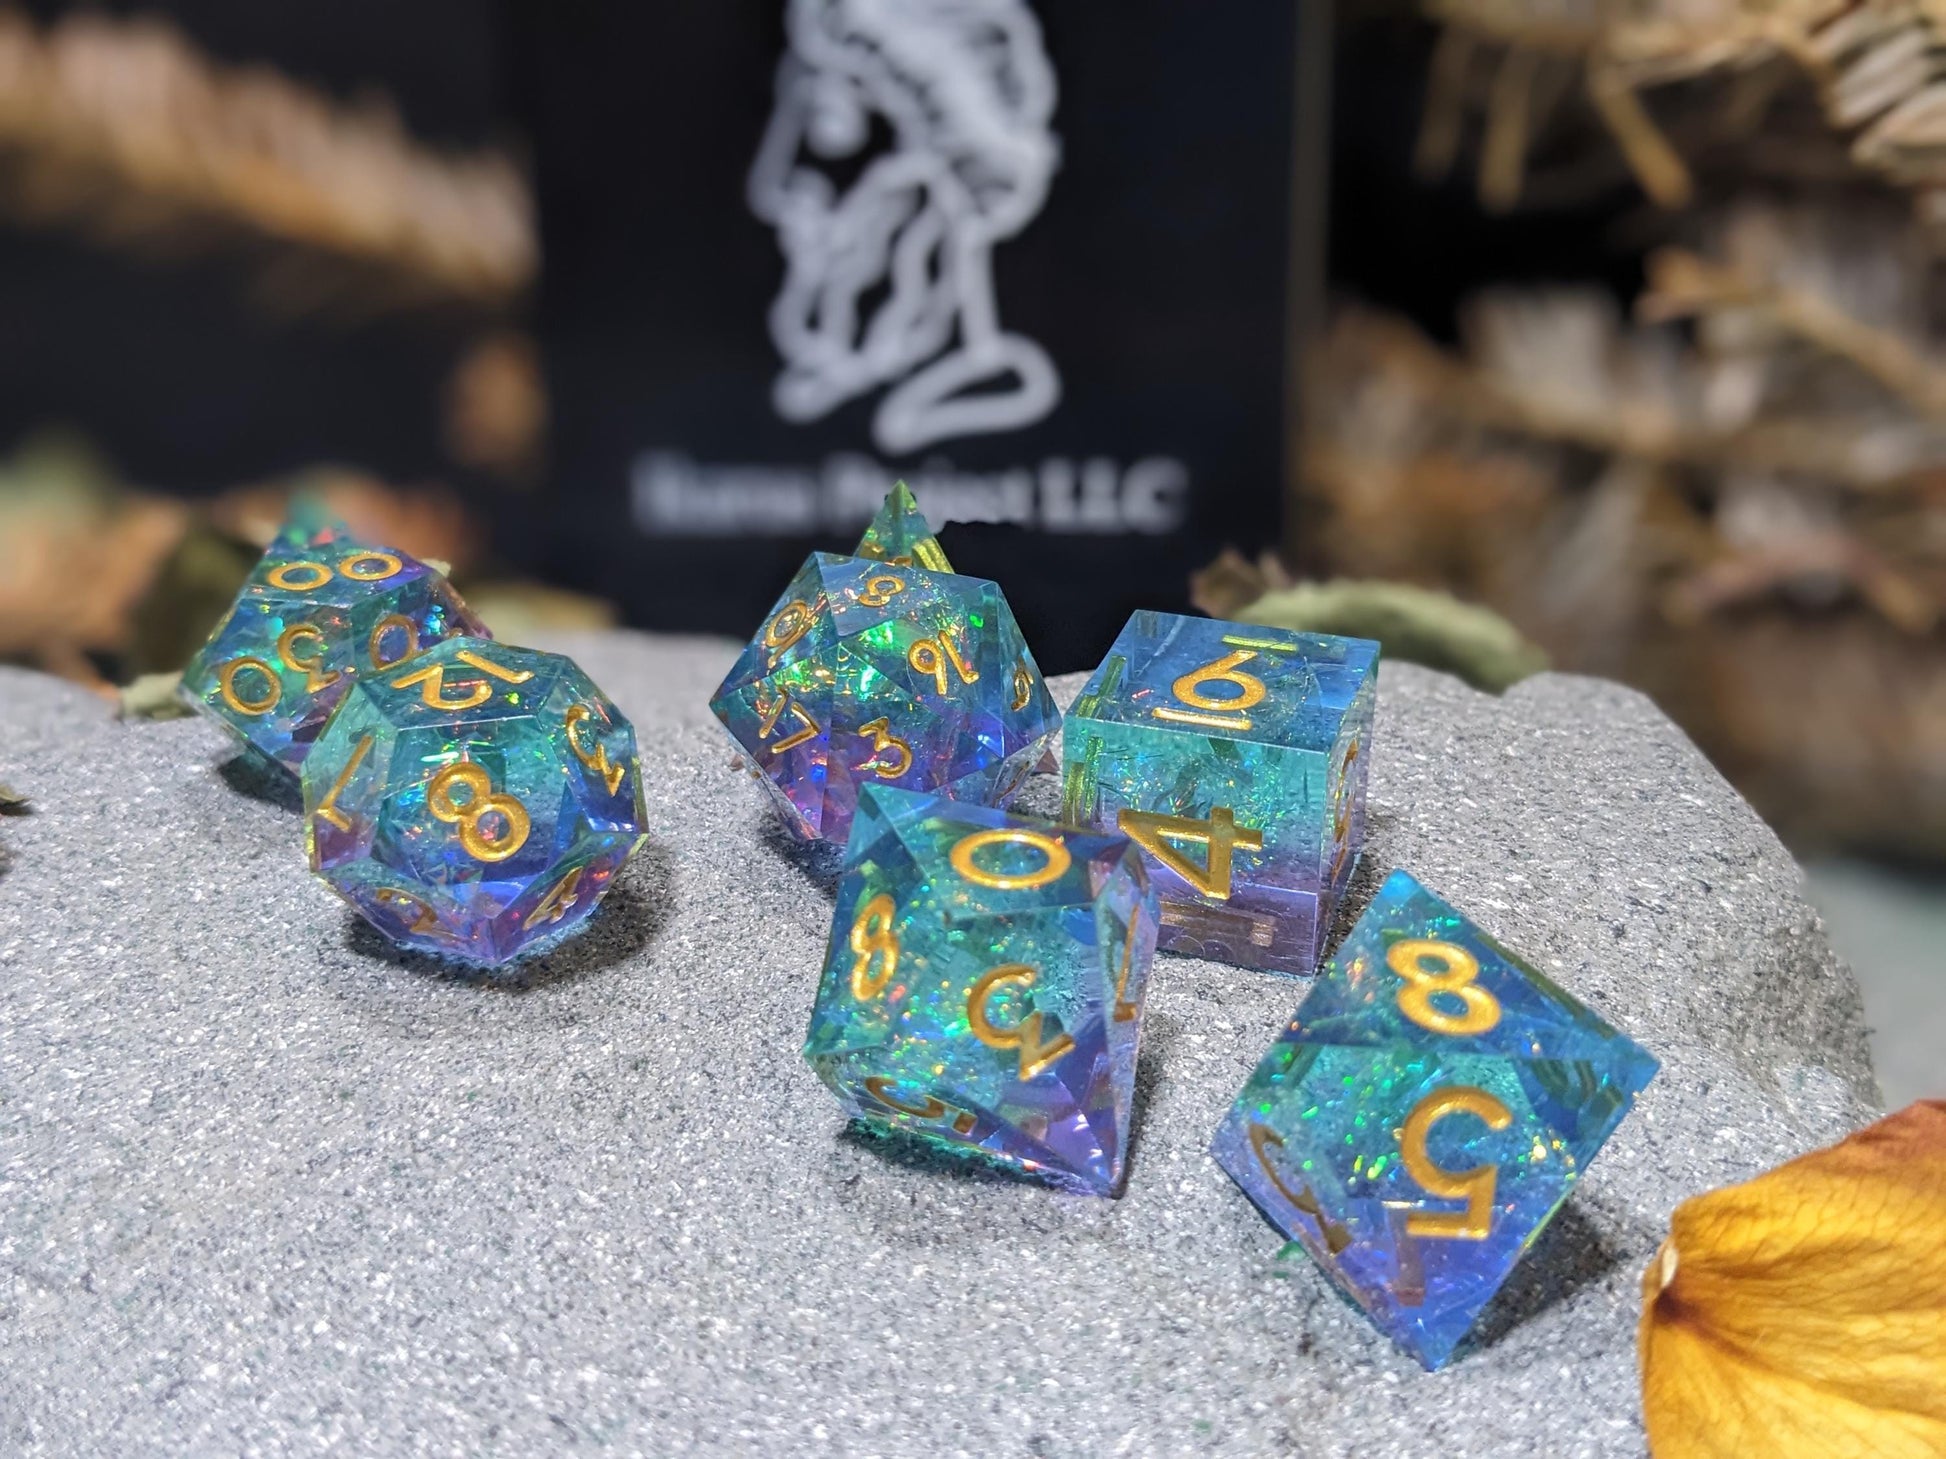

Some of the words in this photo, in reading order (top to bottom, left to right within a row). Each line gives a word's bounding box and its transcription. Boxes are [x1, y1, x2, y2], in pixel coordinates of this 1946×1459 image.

[267, 552, 403, 591] 00
[858, 716, 912, 779] 3
[429, 762, 531, 862] 8
[949, 829, 1072, 889] 0
[1117, 807, 1263, 900] 4
[850, 894, 899, 1001] 8
[1386, 938, 1502, 1036] 8
[967, 963, 1076, 1082] 3
[1402, 1085, 1514, 1241] 5
